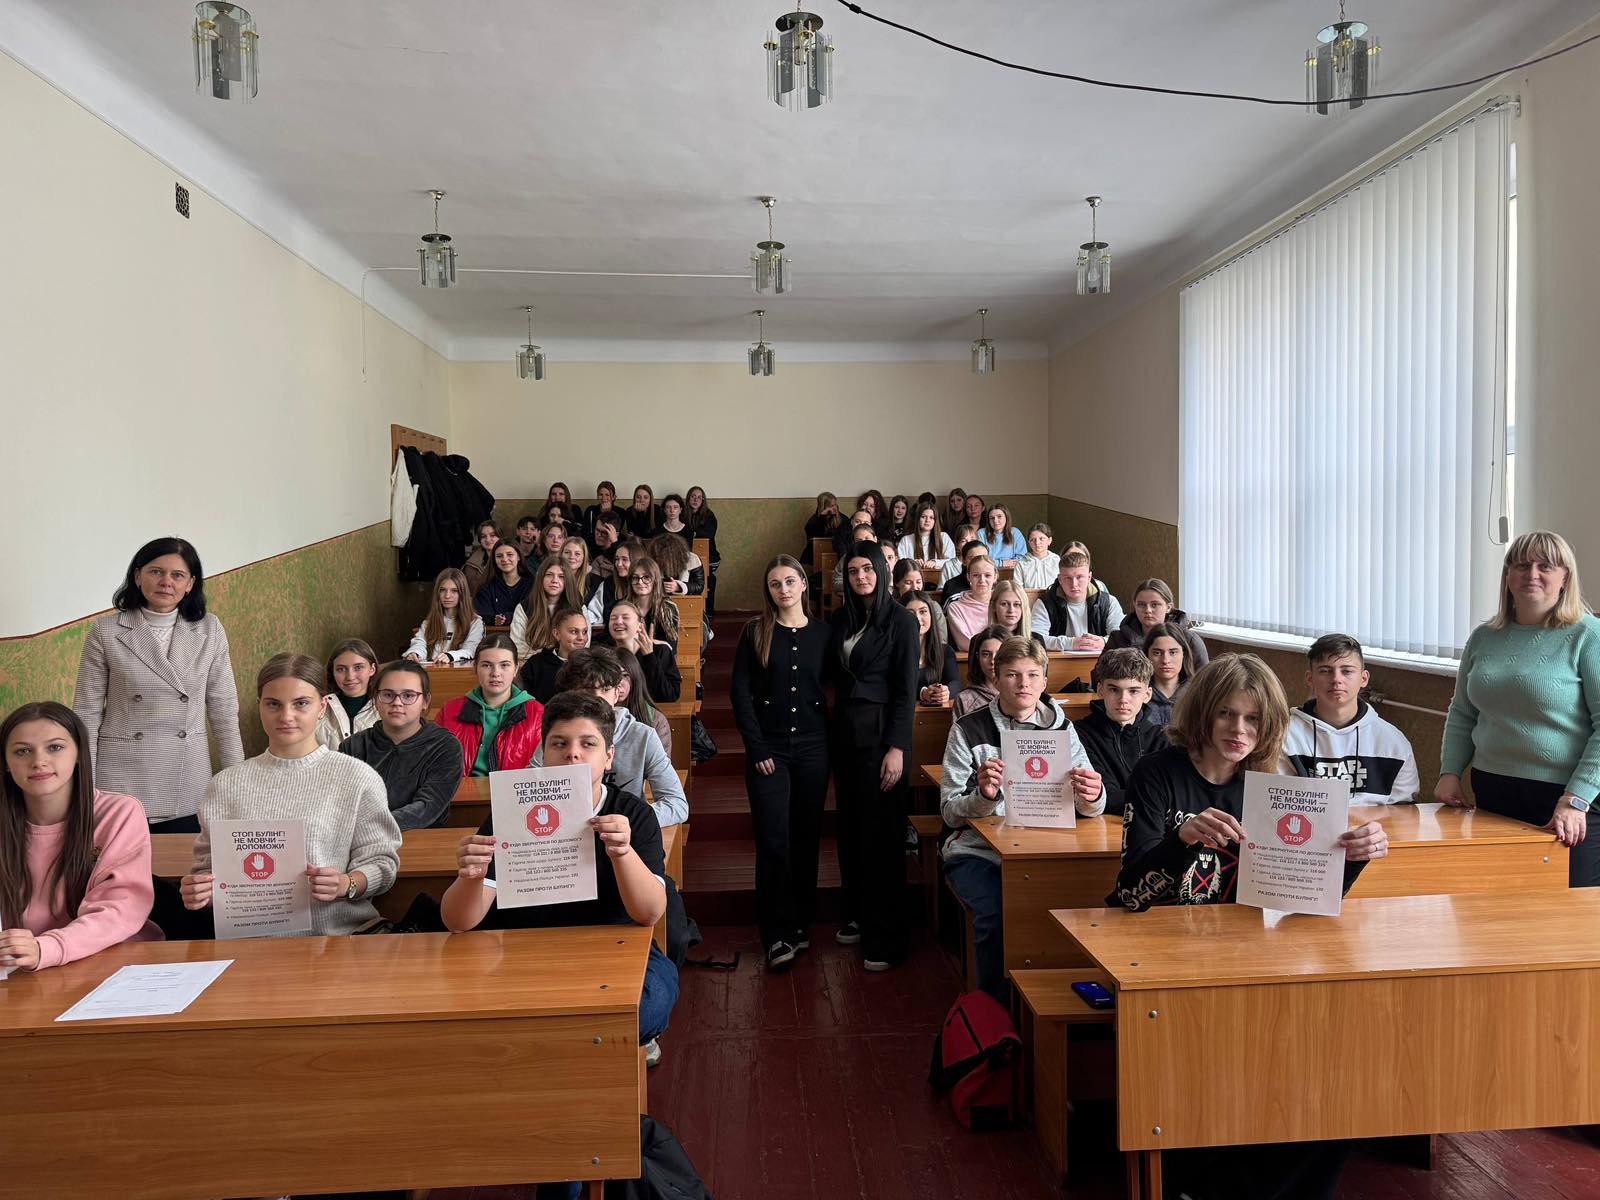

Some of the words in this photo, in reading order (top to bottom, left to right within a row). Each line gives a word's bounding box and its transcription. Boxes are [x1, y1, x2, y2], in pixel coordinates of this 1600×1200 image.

[1315, 760, 1367, 776] STAR
[539, 778, 570, 787] БУЛІНГ!
[530, 787, 561, 796] МОВЧИ
[1268, 787, 1292, 796] СТОП
[1294, 790, 1328, 799] БУЛІНГ!
[518, 794, 570, 804] ДОПОМОЖИ
[1284, 797, 1317, 805] МОВЧИ
[1271, 802, 1326, 813] ДОПОМОЖИ
[1283, 835, 1304, 843] STOP
